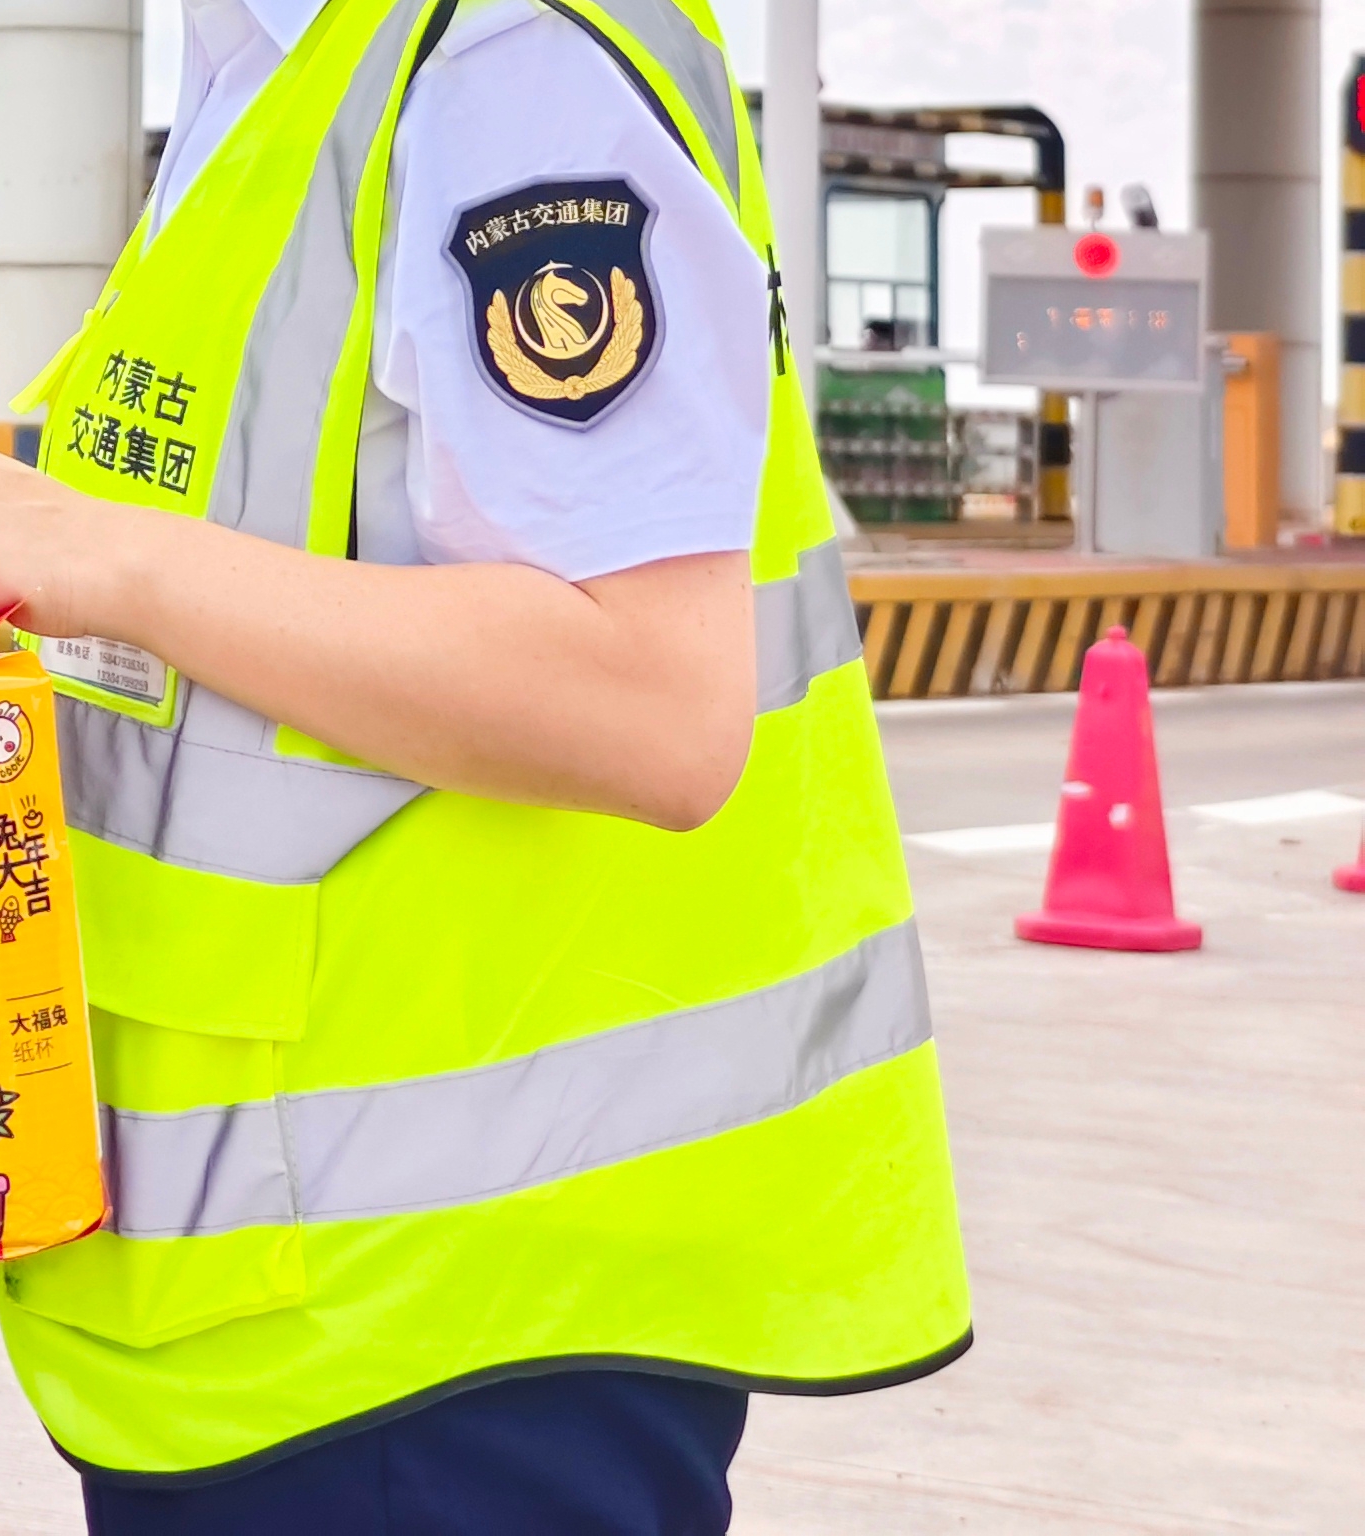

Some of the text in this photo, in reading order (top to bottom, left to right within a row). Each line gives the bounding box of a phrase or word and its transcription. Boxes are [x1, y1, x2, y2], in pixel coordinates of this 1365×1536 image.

[465, 197, 629, 257] 内蒙古交通集团
[96, 349, 197, 426] 内蒙古
[67, 403, 196, 495] 交通集团
[9, 1004, 68, 1036] 大福兔
[13, 1036, 54, 1063] 纸杯
